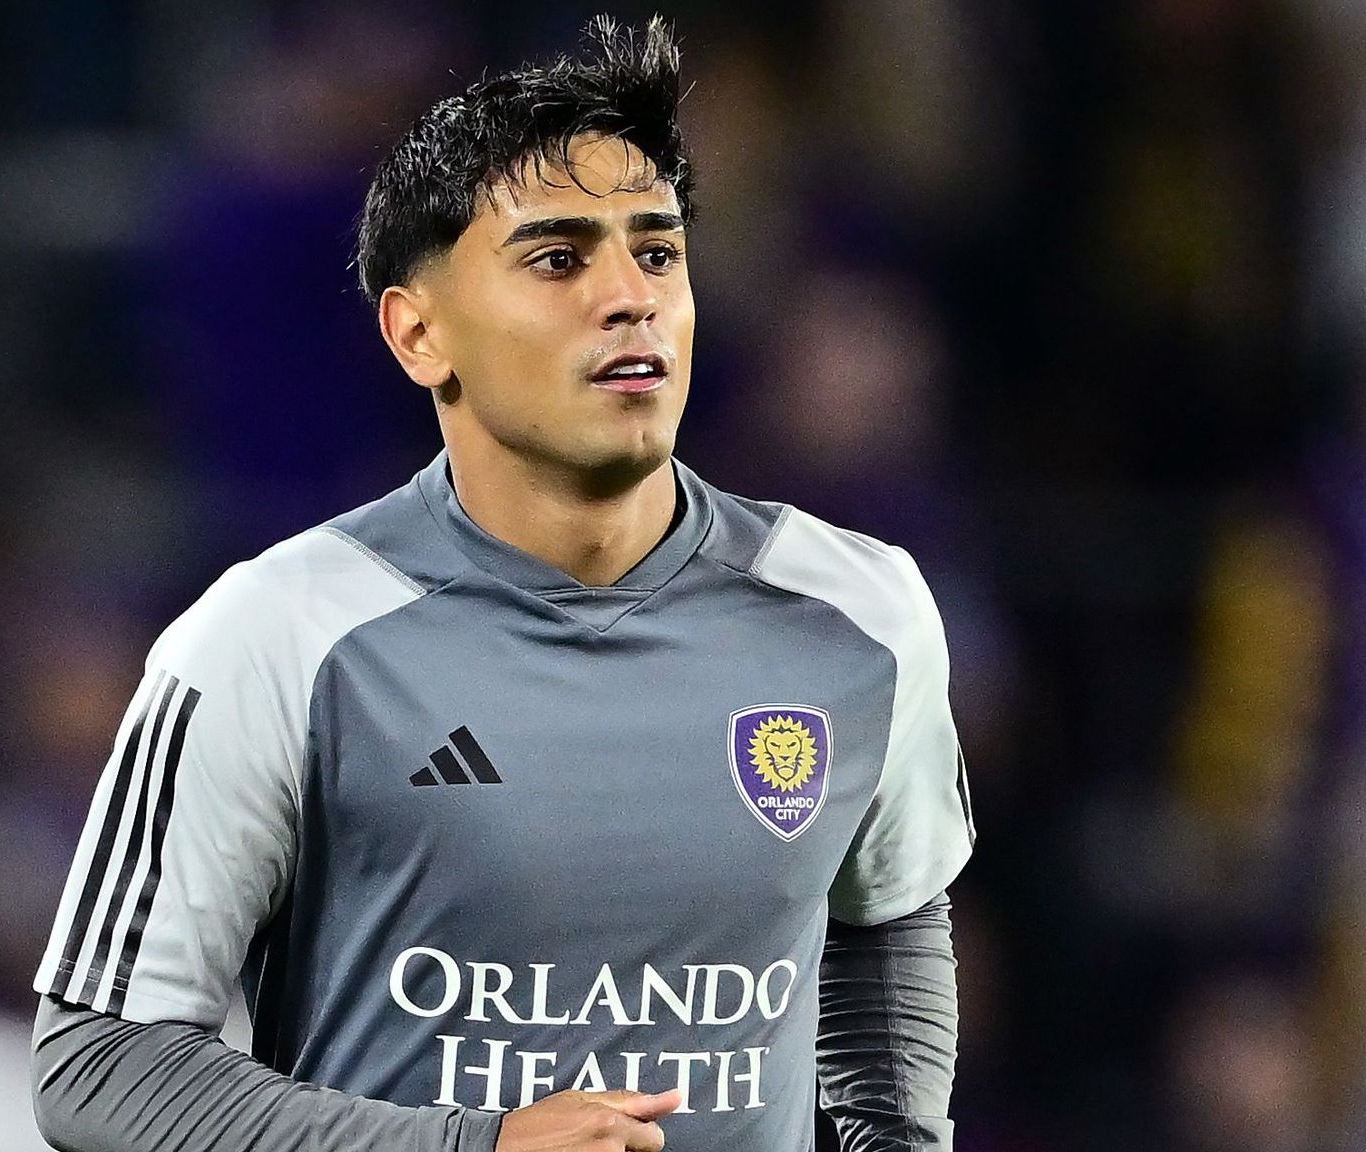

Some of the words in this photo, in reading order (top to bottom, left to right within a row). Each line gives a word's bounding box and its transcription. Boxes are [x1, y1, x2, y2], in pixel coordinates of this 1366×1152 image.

[757, 796, 815, 809] ORLANDO
[775, 808, 801, 821] CITY
[389, 946, 798, 1026] ORLANDO
